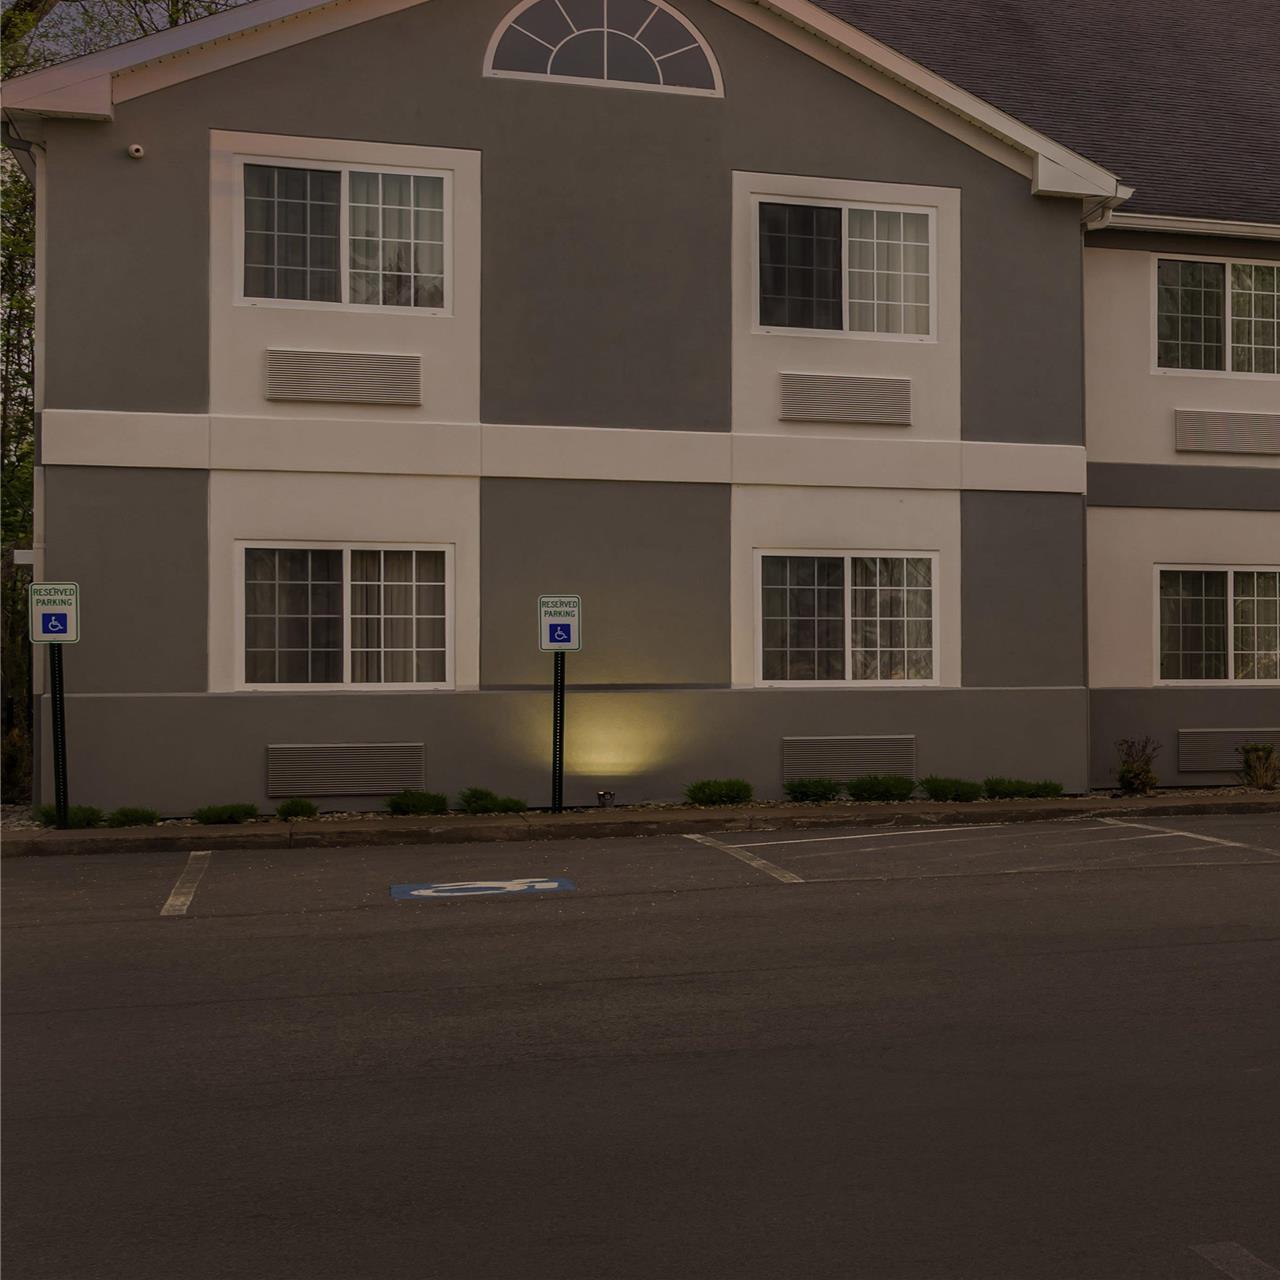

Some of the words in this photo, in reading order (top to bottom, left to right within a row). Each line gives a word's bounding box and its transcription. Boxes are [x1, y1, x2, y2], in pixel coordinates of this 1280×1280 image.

[32, 588, 76, 597] RESERVED
[35, 598, 73, 607] PARKING
[541, 600, 578, 609] RESERVED
[543, 610, 576, 618] PARKING
